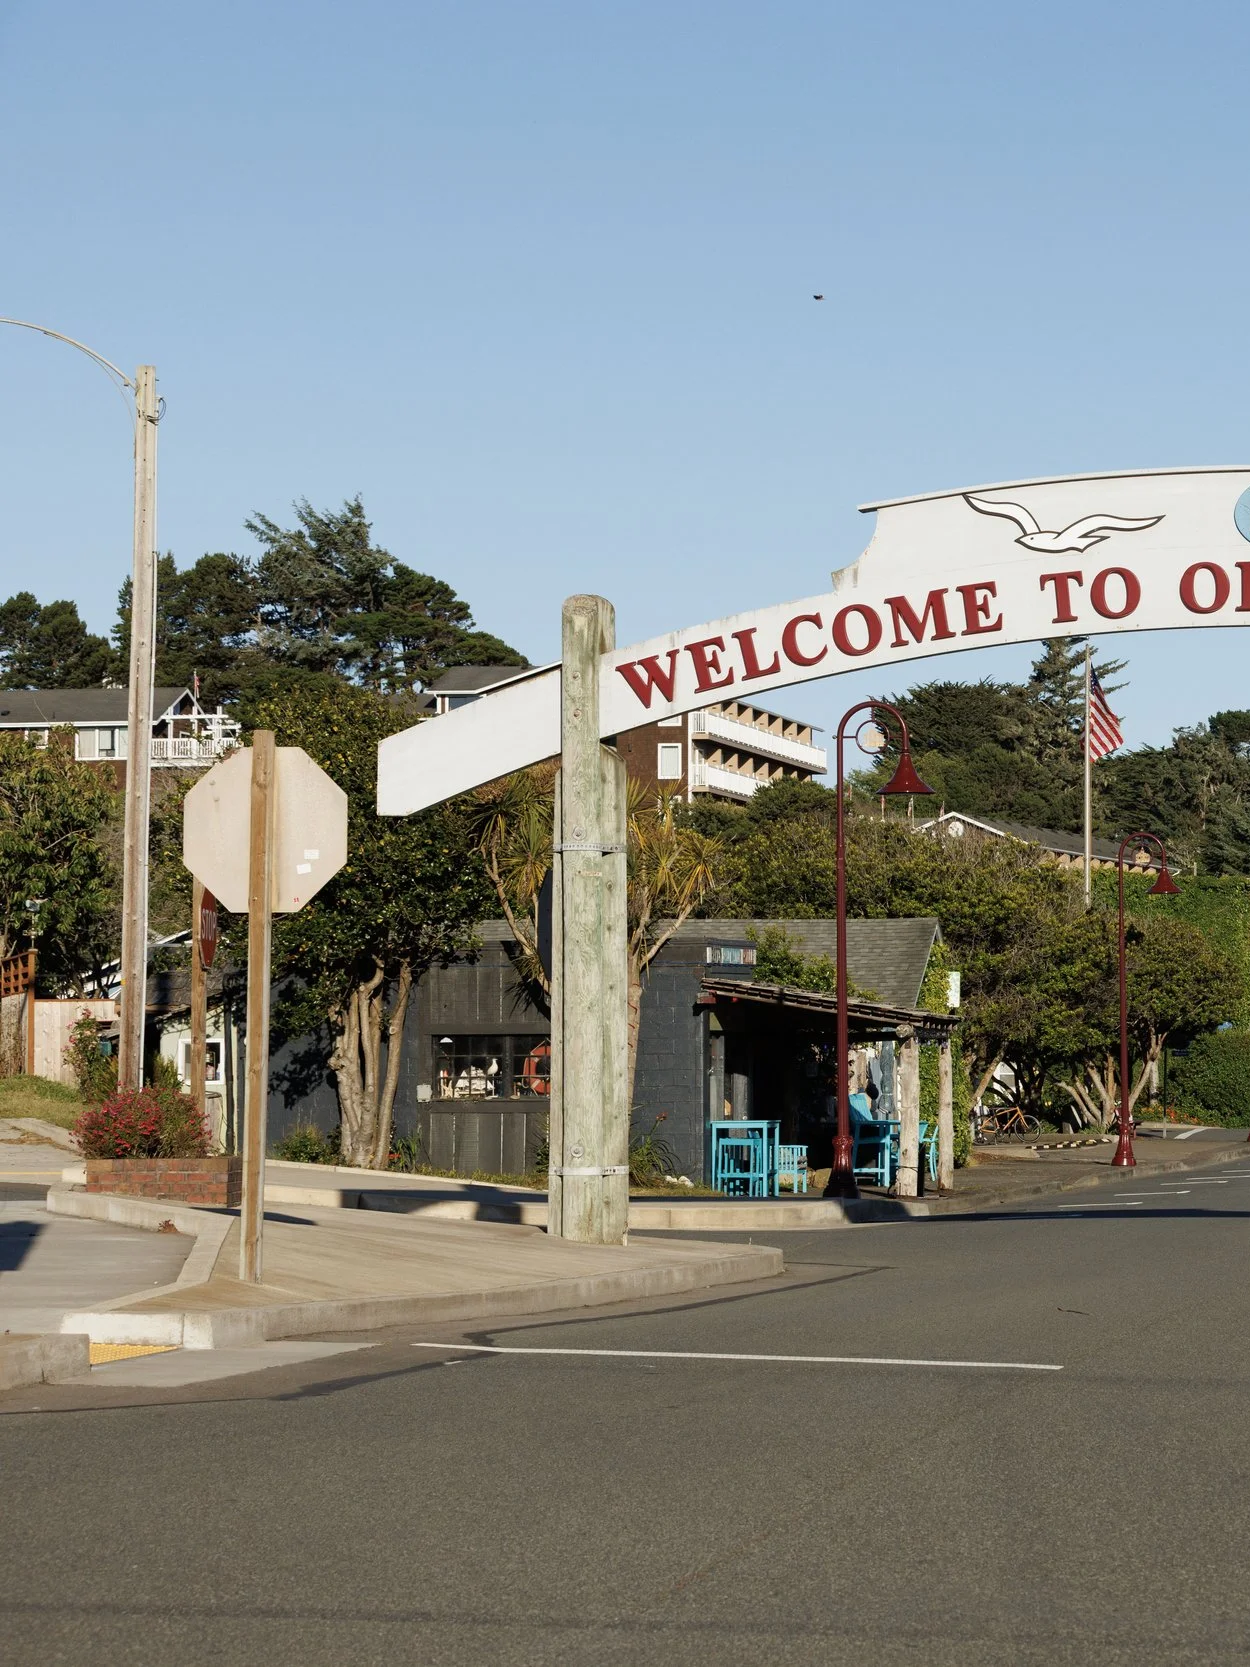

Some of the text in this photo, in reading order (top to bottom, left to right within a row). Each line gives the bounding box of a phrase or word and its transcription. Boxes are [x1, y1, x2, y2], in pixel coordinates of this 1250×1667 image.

[616, 581, 1003, 708] WELCOME
[1040, 568, 1141, 622] TO
[201, 907, 217, 941] STOP
